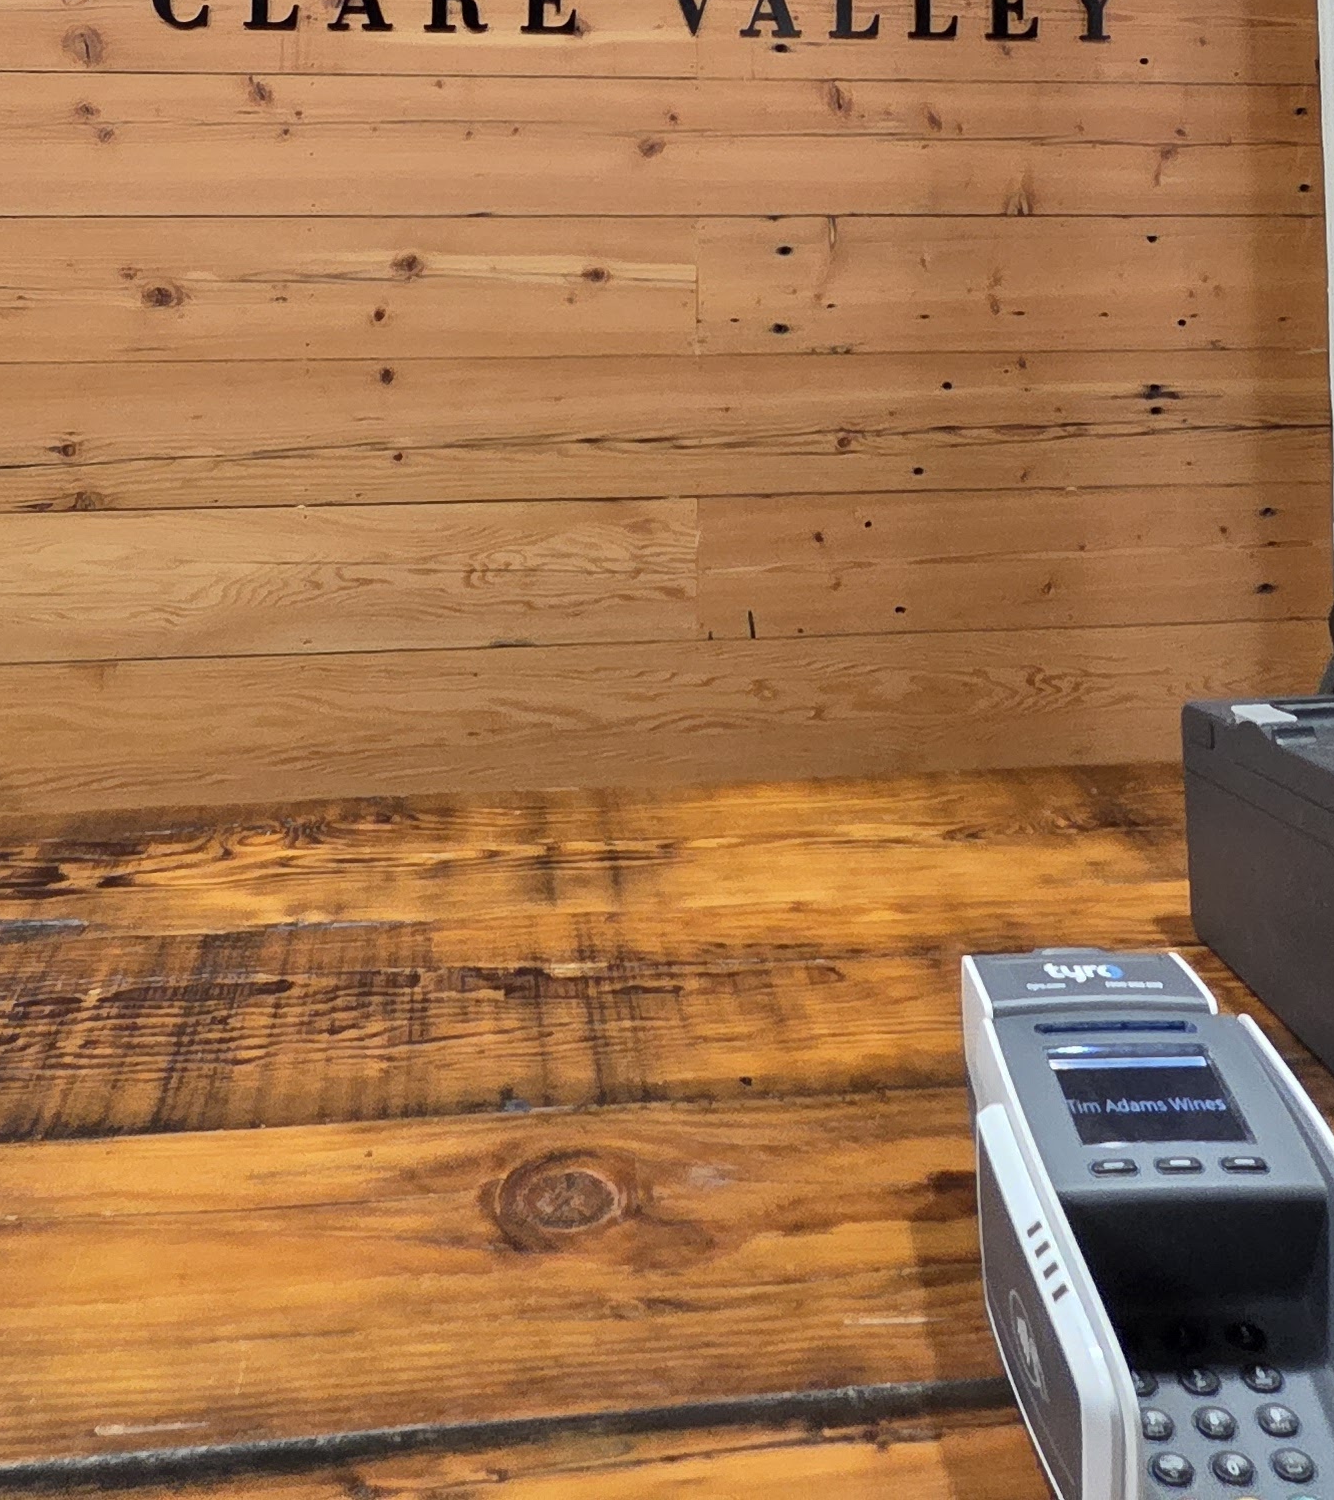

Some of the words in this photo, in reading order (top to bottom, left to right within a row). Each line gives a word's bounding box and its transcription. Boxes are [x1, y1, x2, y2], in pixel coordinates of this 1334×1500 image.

[1042, 962, 1125, 983] tyro
[1068, 1099, 1102, 1114] Tim
[1105, 1097, 1168, 1114] Adams
[1168, 1096, 1227, 1113] Wines
